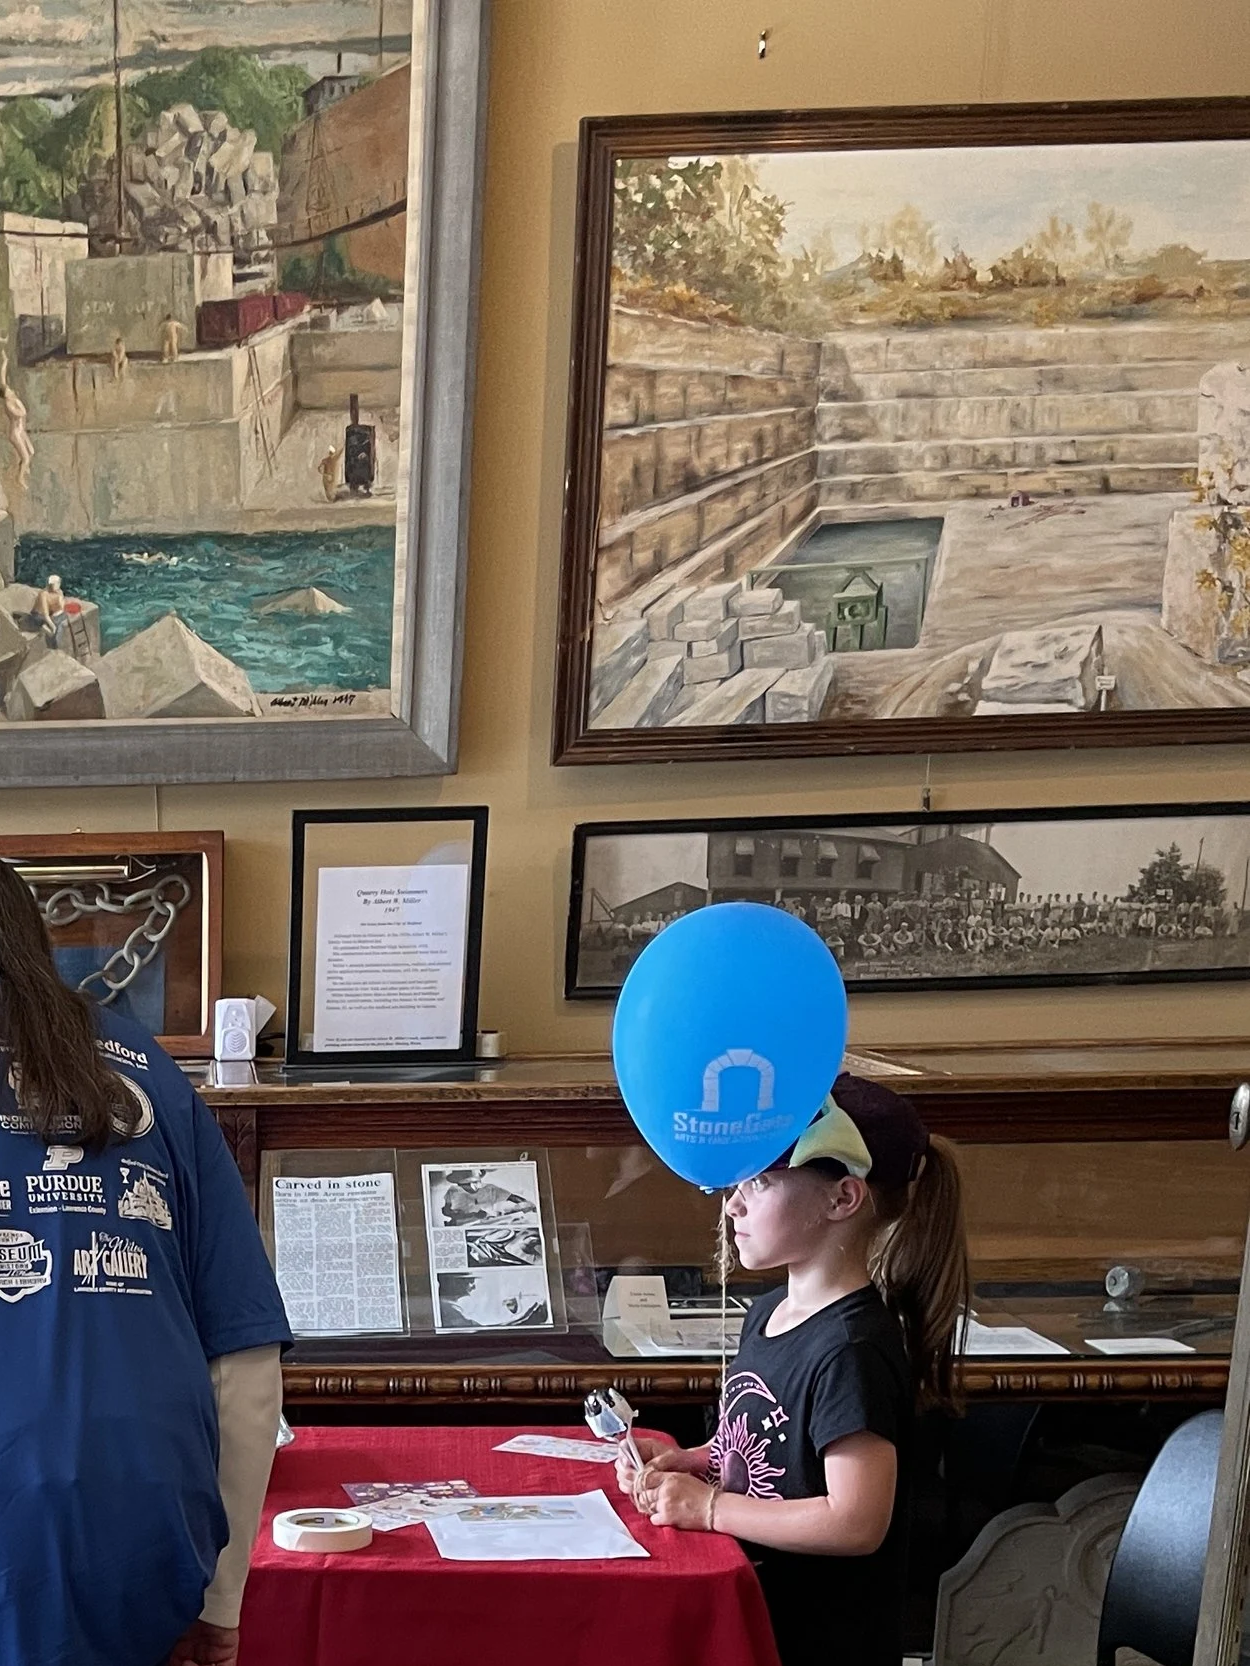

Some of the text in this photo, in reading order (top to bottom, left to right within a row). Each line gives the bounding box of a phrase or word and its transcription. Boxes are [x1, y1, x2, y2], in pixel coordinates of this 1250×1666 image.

[95, 1039, 148, 1064] edford
[673, 1111, 794, 1137] StoneGate
[42, 1145, 85, 1171] P
[25, 1175, 104, 1193] PURDUE
[275, 1179, 382, 1189] Carved in stone
[102, 1249, 148, 1280] GALLERY
